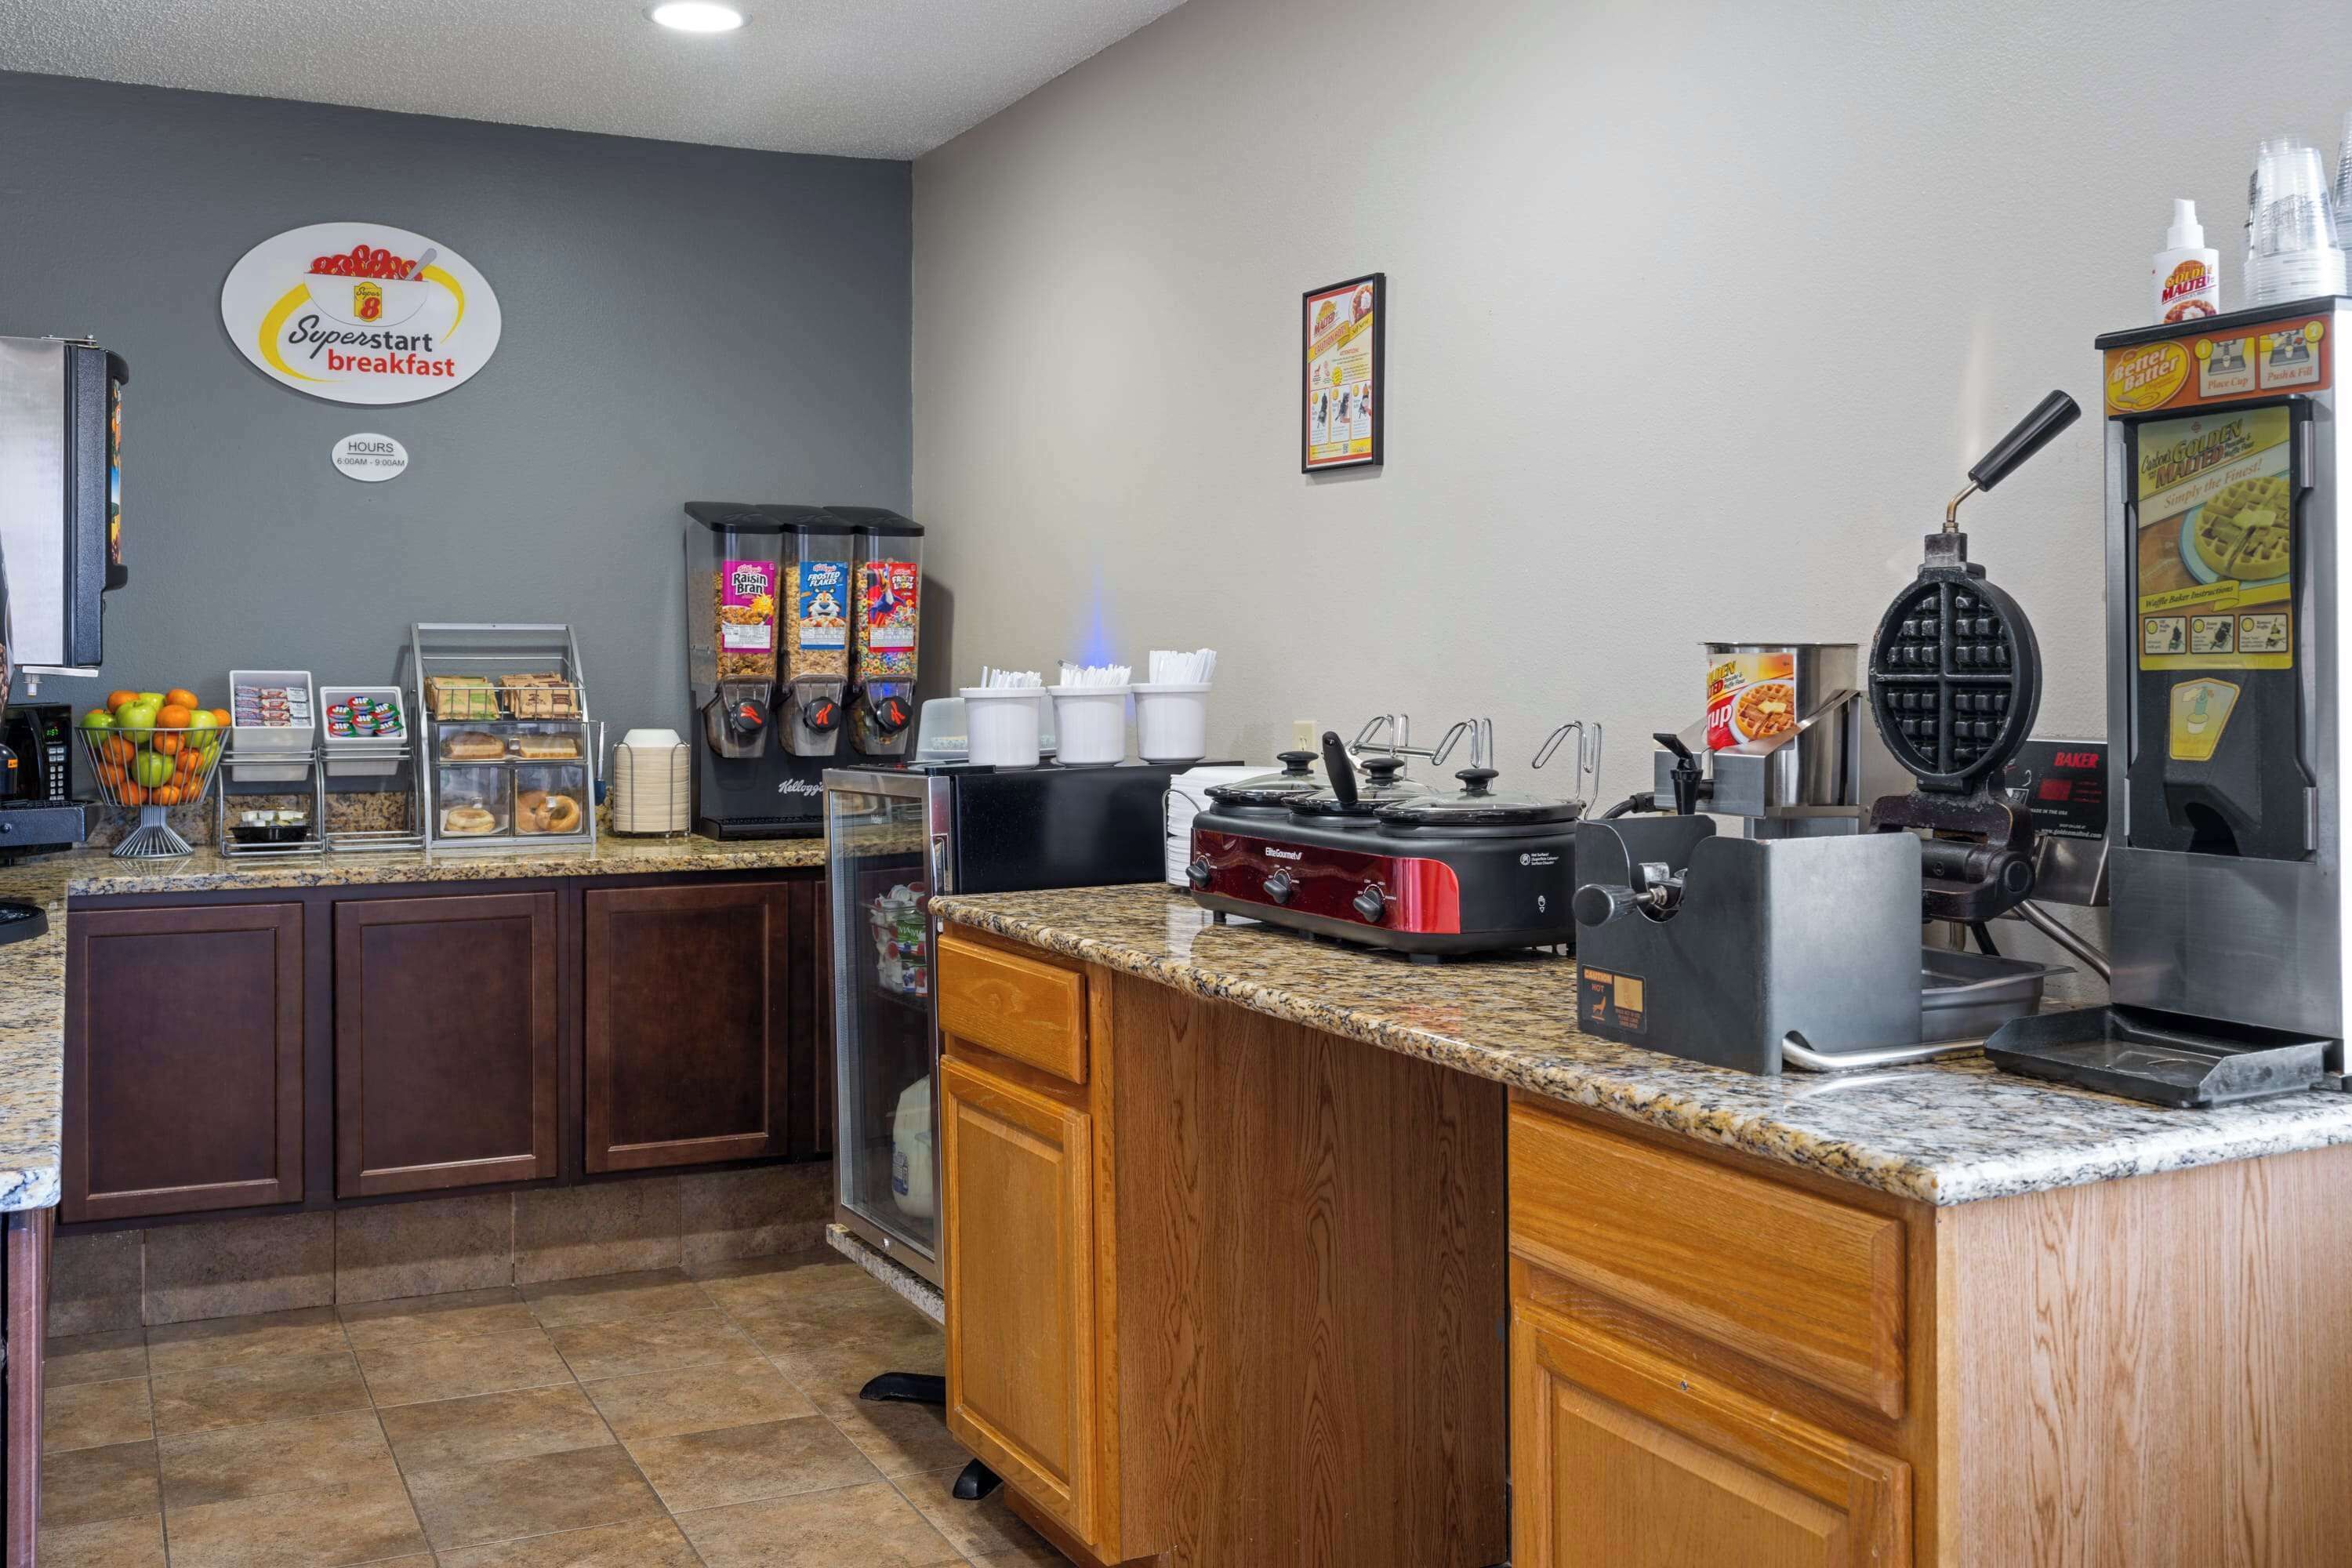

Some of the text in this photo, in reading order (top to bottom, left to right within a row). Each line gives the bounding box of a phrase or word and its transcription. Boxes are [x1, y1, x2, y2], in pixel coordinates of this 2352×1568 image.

[356, 286, 380, 299] Super
[361, 297, 380, 319] 8
[328, 349, 455, 377] breakfast
[2113, 345, 2171, 384] Better
[2122, 354, 2180, 394] Batter
[2267, 370, 2288, 381] Push
[2298, 366, 2314, 376] Fill
[2207, 377, 2249, 390] Place Cup
[348, 441, 394, 453] HOURS
[2172, 417, 2244, 464] GOLDEN
[2155, 445, 2225, 489] MALTED
[2164, 458, 2263, 509] Simply the Finest!
[733, 573, 767, 585] Raisin
[808, 572, 840, 581] FROSTED
[809, 578, 837, 587] FLAKES
[891, 575, 914, 584] FROOT
[737, 583, 763, 594] Bran
[893, 582, 913, 590] LOOPS
[2145, 586, 2234, 608] Waffle Baker Instructions
[2054, 752, 2100, 768] BAKER
[779, 779, 823, 797] Kellogg's
[1584, 969, 1613, 984] CAUTION
[1592, 983, 1605, 993] HOT
